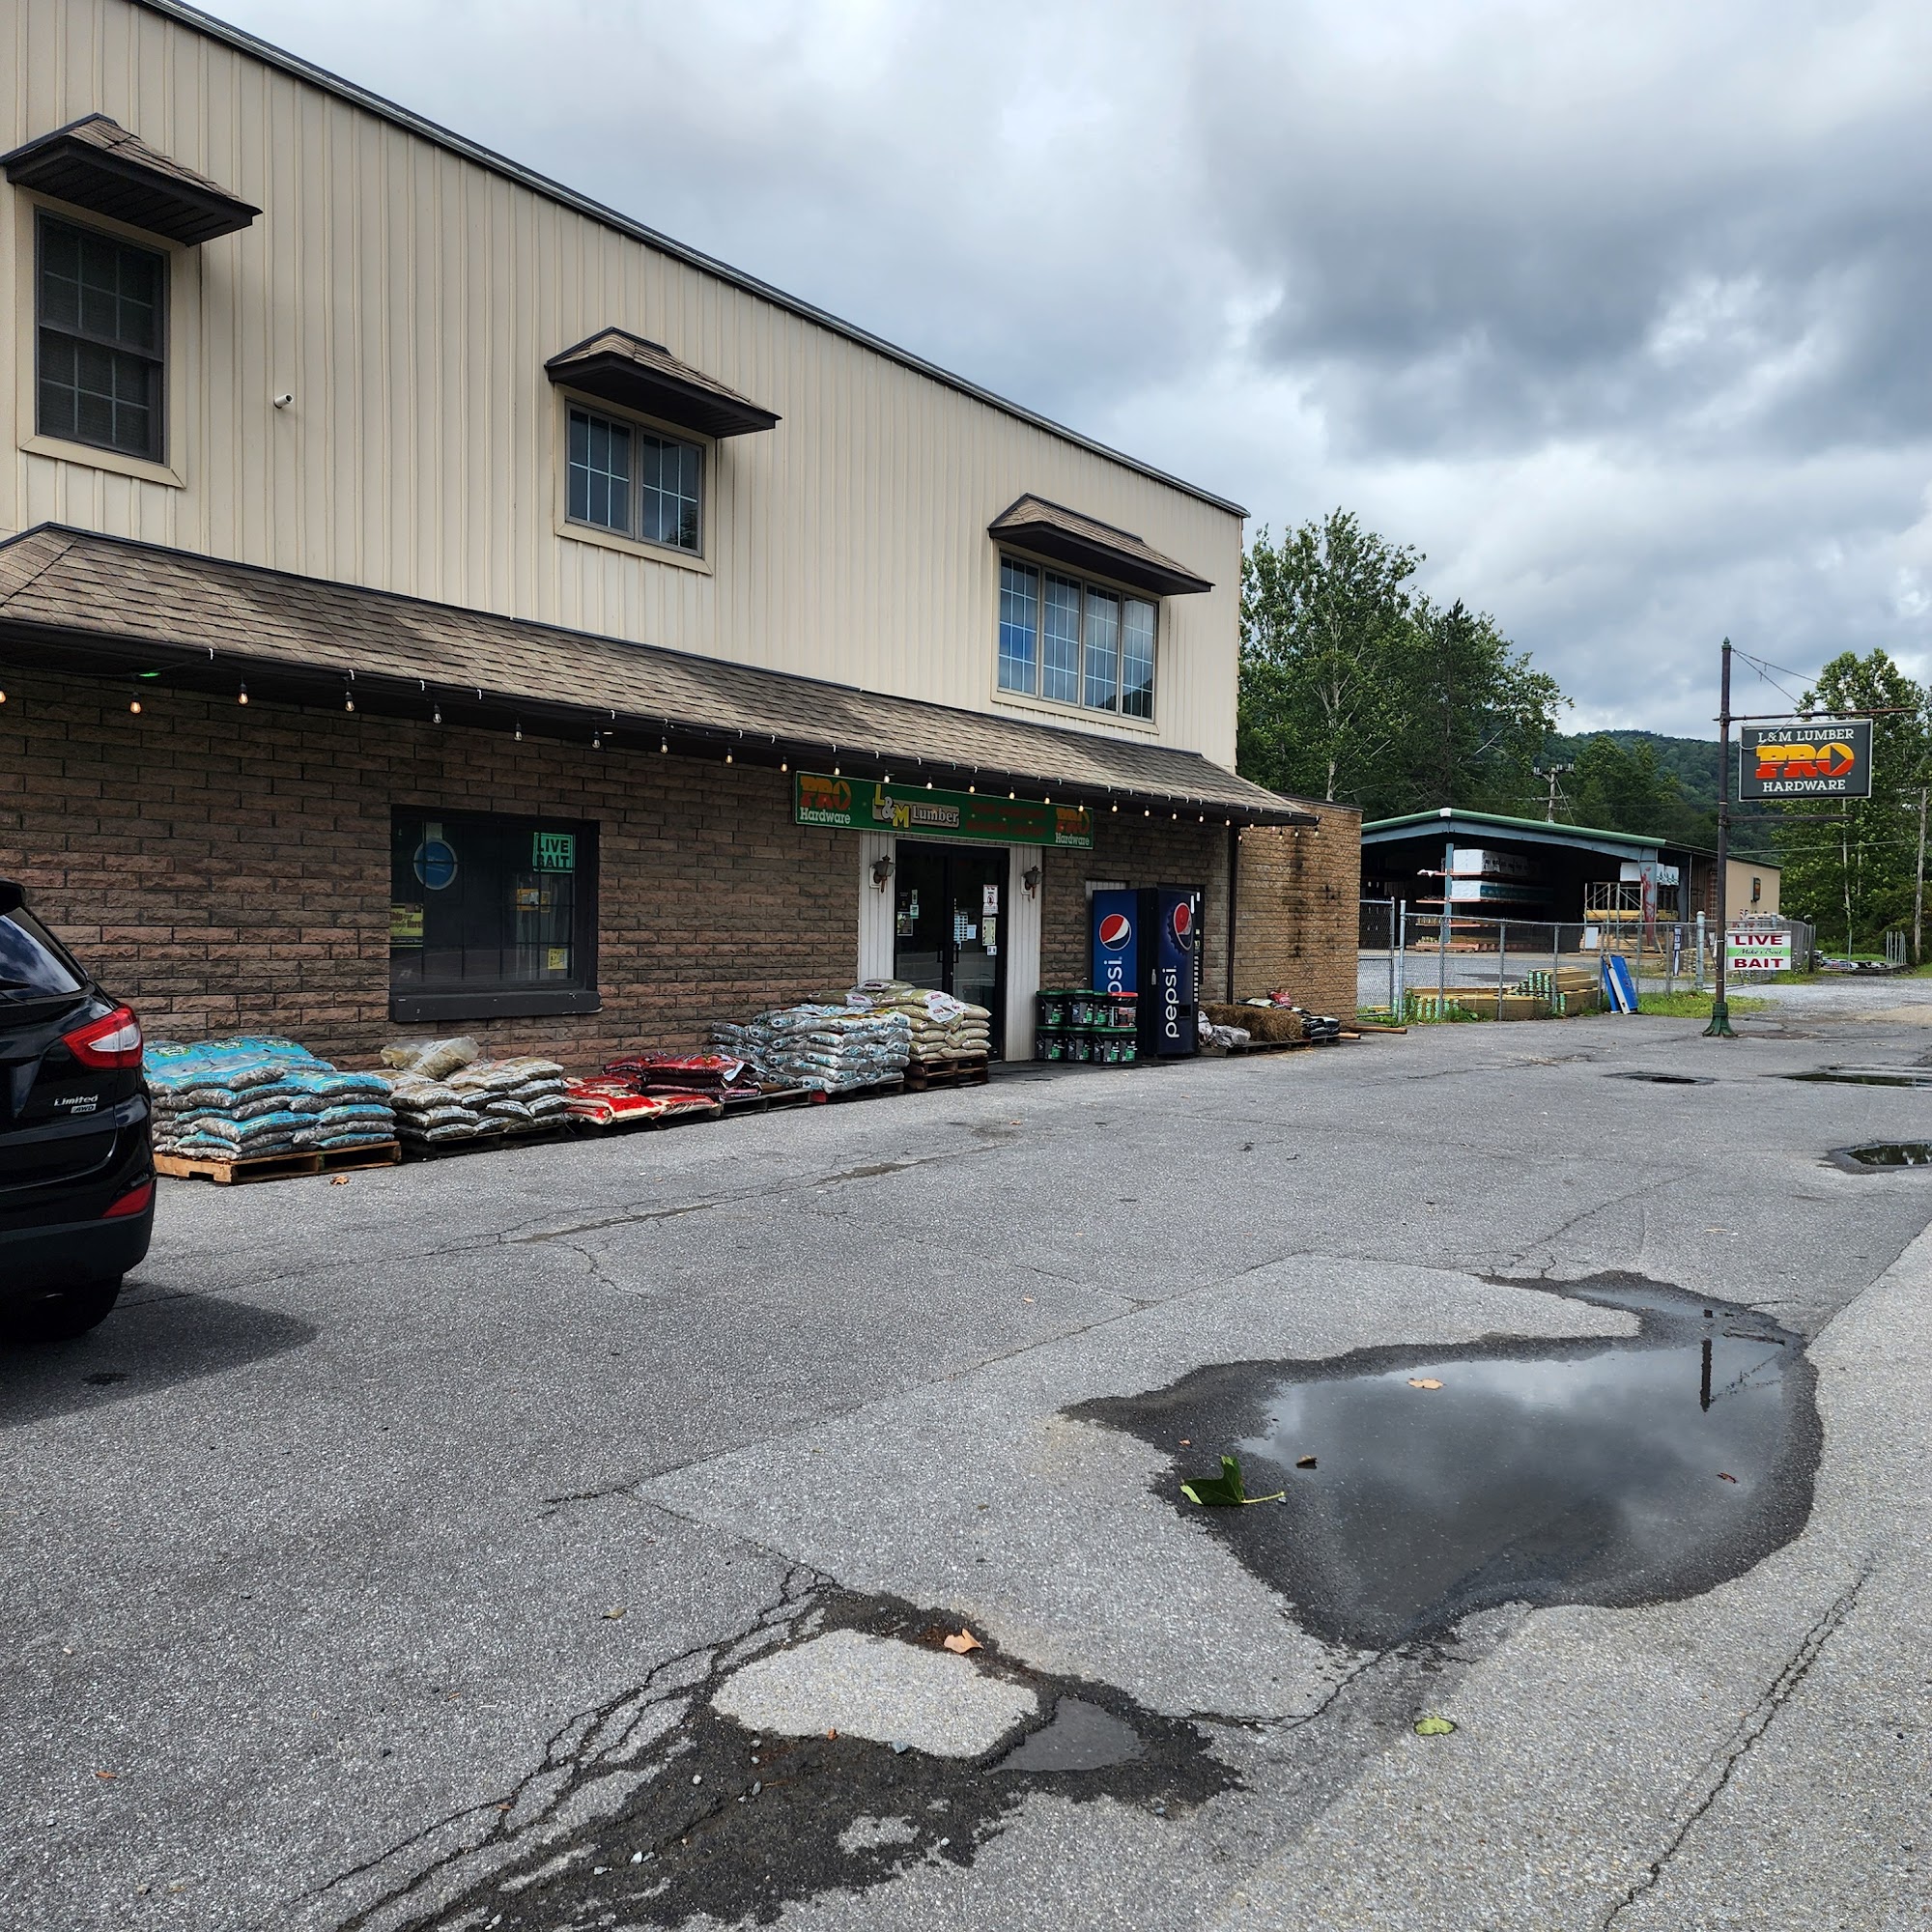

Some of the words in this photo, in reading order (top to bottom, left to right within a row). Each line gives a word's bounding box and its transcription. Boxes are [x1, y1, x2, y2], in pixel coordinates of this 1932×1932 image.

[1758, 730, 1792, 743] L&M
[1796, 727, 1855, 741] LUMBER
[1755, 742, 1855, 780] PRO
[800, 775, 852, 810] PRO
[1762, 779, 1846, 792] HARDWARE
[874, 783, 910, 829] L&M
[912, 805, 958, 823] Lumber
[800, 807, 851, 825] Hardware
[537, 838, 569, 853] LIVE
[1055, 832, 1090, 846] Hardware
[537, 854, 570, 868] BAIT
[1735, 934, 1783, 946] LIVE
[1734, 958, 1784, 968] BAIT
[1162, 968, 1180, 1038] pepsi
[54, 1094, 99, 1106] Limited
